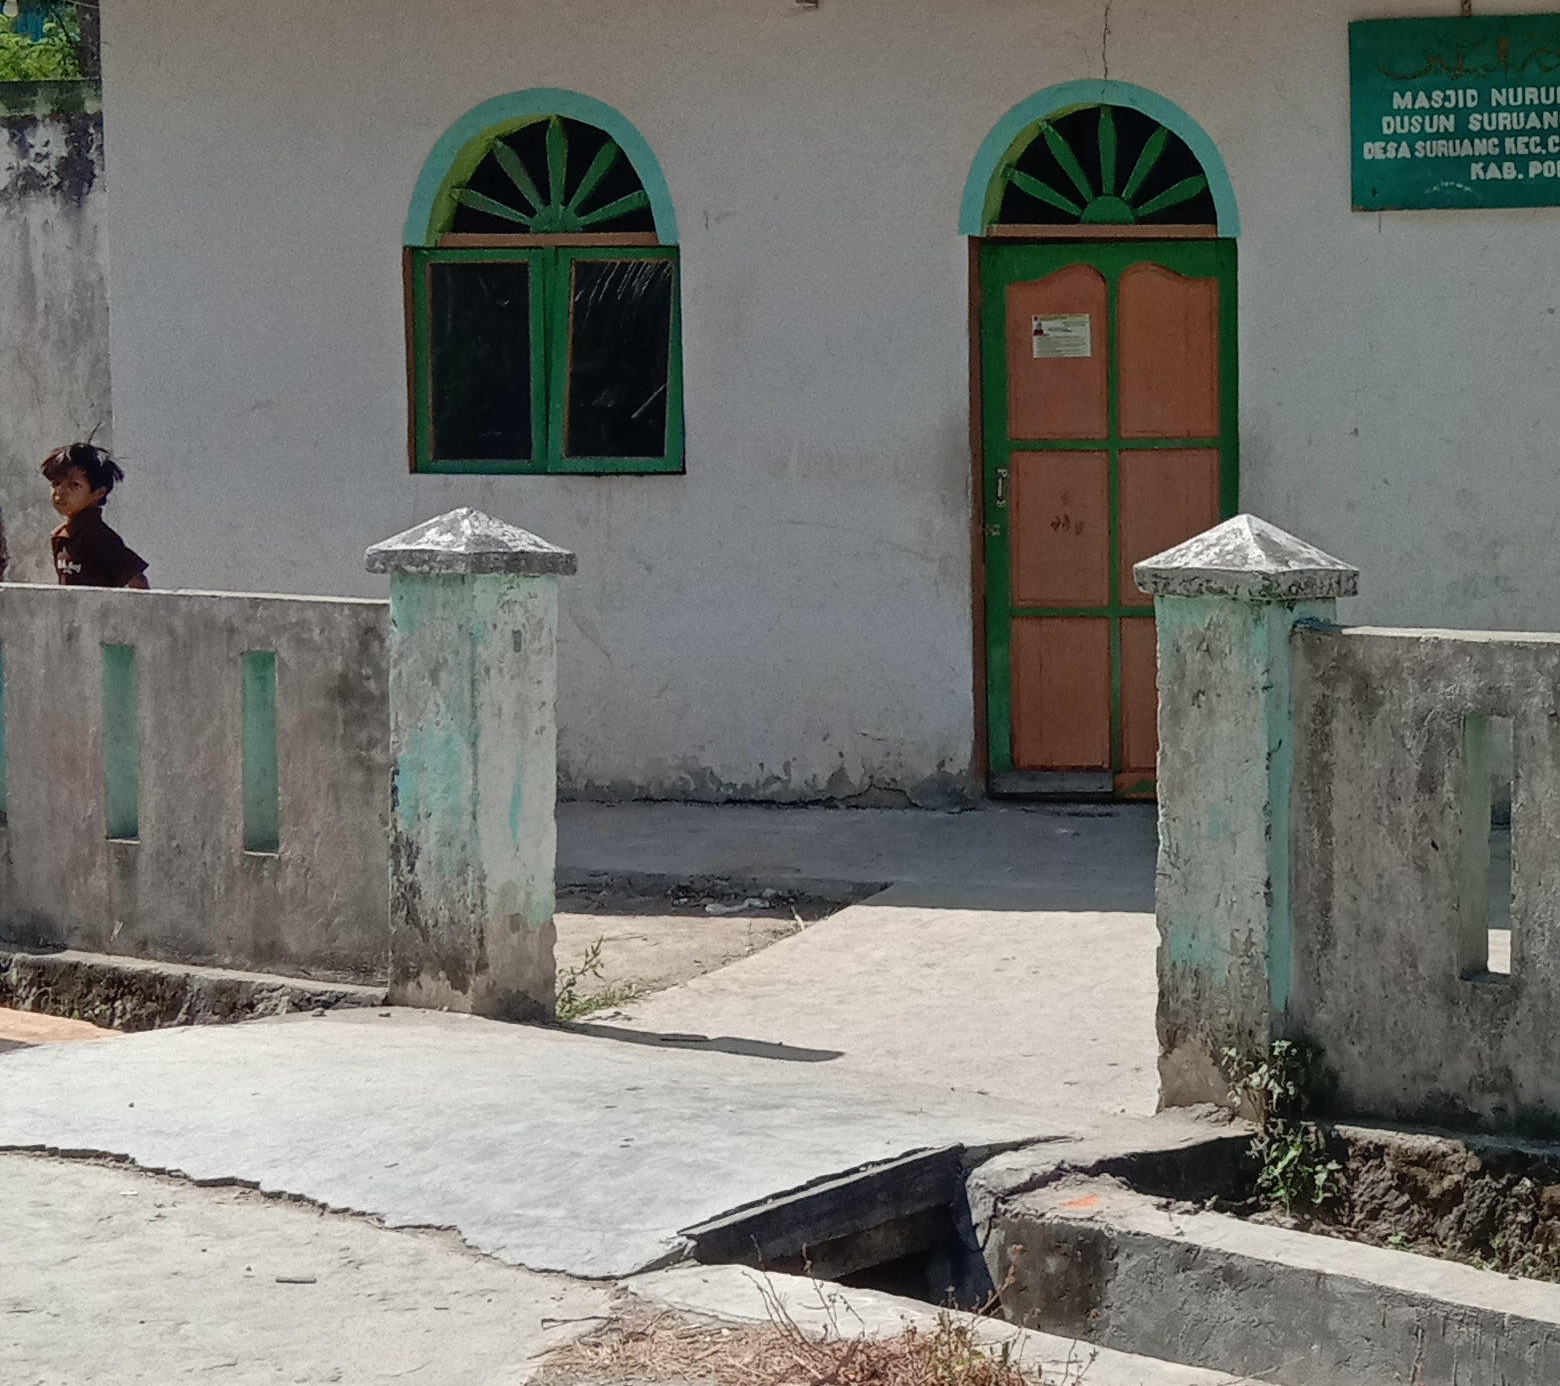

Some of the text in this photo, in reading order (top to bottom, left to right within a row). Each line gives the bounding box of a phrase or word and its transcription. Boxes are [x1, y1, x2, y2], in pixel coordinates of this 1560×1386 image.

[1392, 88, 1478, 110] MASJID
[1382, 115, 1455, 134] DUSUN
[1363, 141, 1411, 160] DESA
[1470, 161, 1523, 180] KAB.
